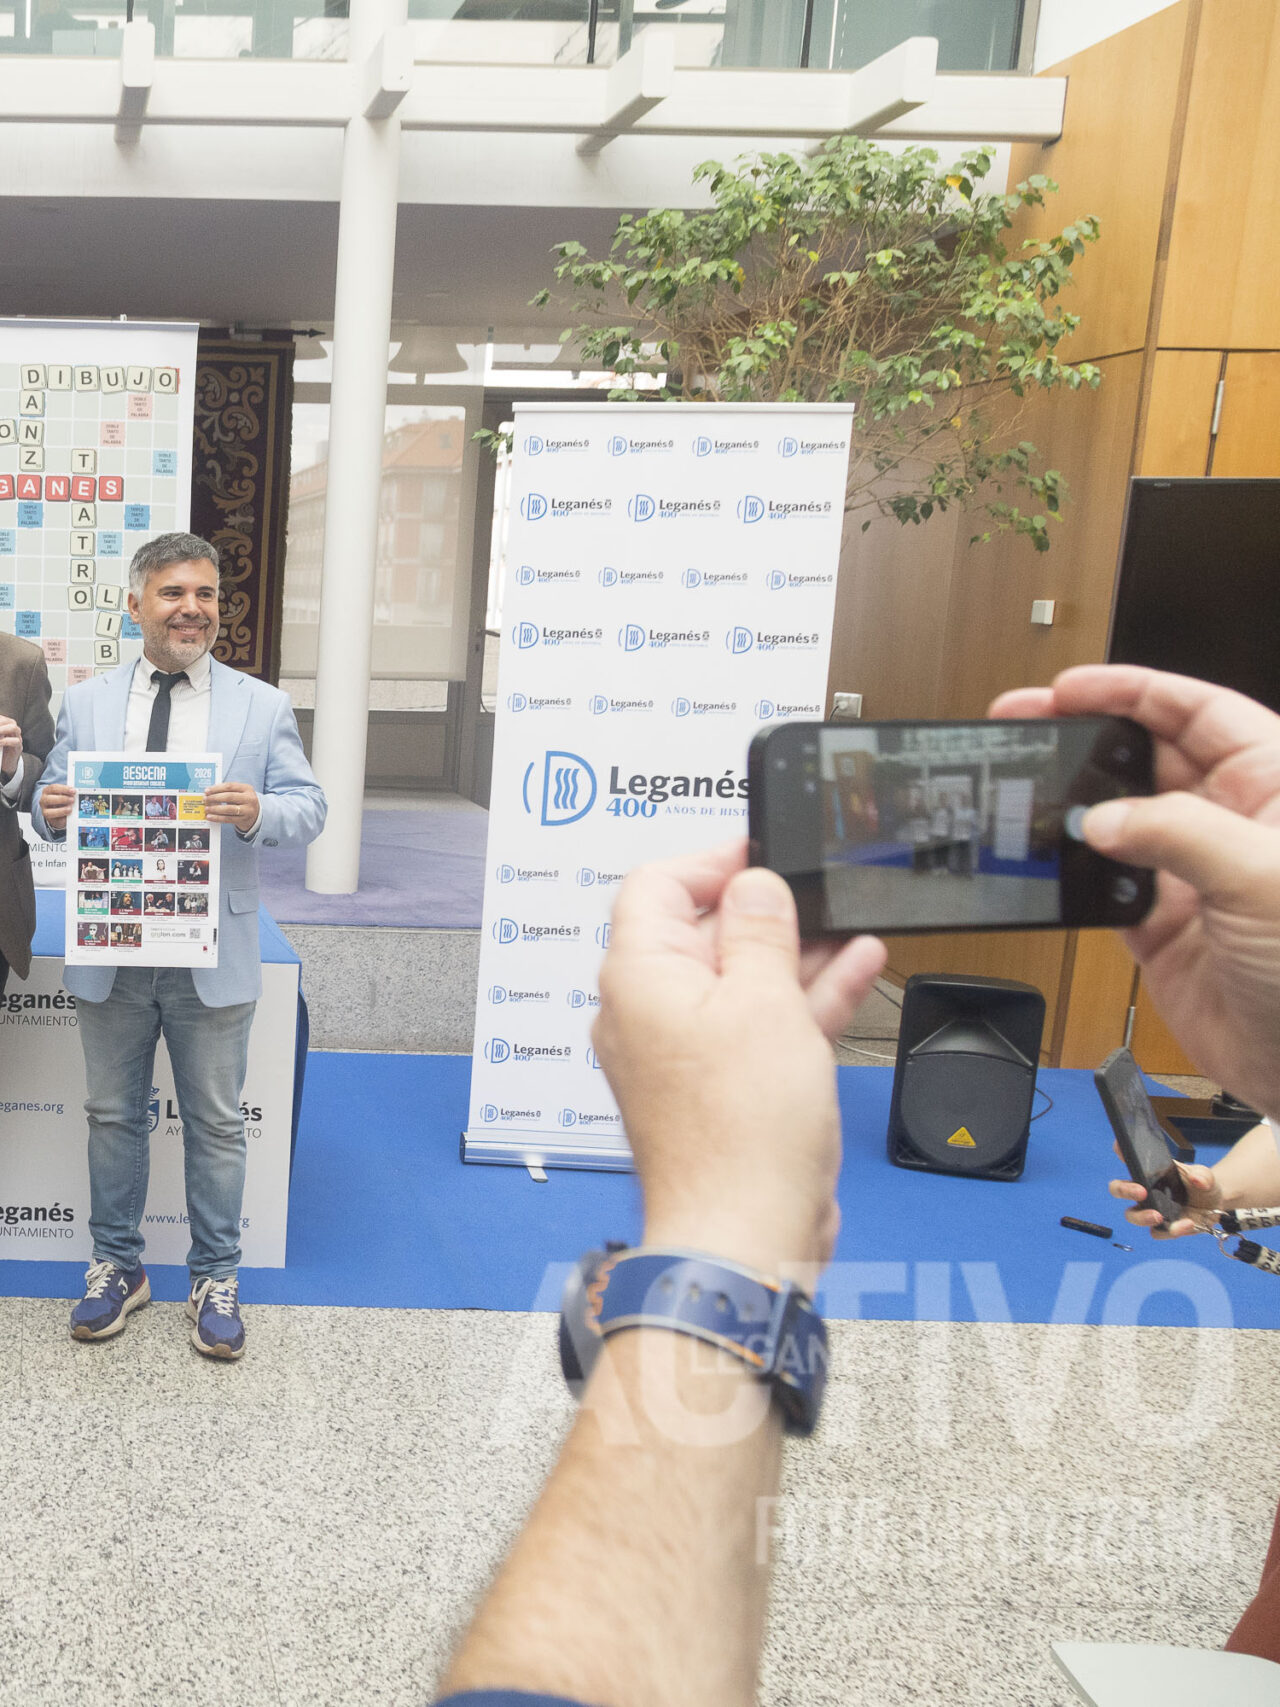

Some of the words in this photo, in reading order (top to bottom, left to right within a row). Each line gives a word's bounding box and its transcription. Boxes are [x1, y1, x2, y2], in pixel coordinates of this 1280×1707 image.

[27, 369, 172, 387] DIBUJO
[546, 439, 583, 449] Leganés
[630, 439, 667, 449] Leganés
[715, 440, 753, 450] Leganés
[801, 441, 839, 451] Leganés
[552, 498, 602, 511] Leganés
[659, 499, 711, 512] Leganés
[769, 500, 822, 513] Leganés
[538, 569, 574, 579] Leganés
[620, 571, 657, 581] Leganés
[704, 572, 742, 582] Leganés
[789, 574, 826, 583] Leganés
[543, 627, 593, 640] Leganés
[649, 629, 700, 642] Leganés
[757, 632, 810, 644] Leganés
[529, 697, 565, 706] Leganés
[611, 699, 647, 709] Leganés
[693, 701, 730, 711] Leganés
[777, 703, 814, 713] Leganés
[609, 766, 749, 802] Leganés
[606, 797, 657, 818] 400
[701, 807, 714, 815] DE
[720, 808, 748, 817] HIST
[517, 869, 552, 879] Leganés
[597, 872, 623, 882] Legan
[522, 924, 571, 936] Leganés
[509, 990, 544, 1000] Leganés
[514, 1044, 562, 1056] Leganés
[500, 1109, 535, 1119] Leganés
[579, 1112, 614, 1122] Leganés
